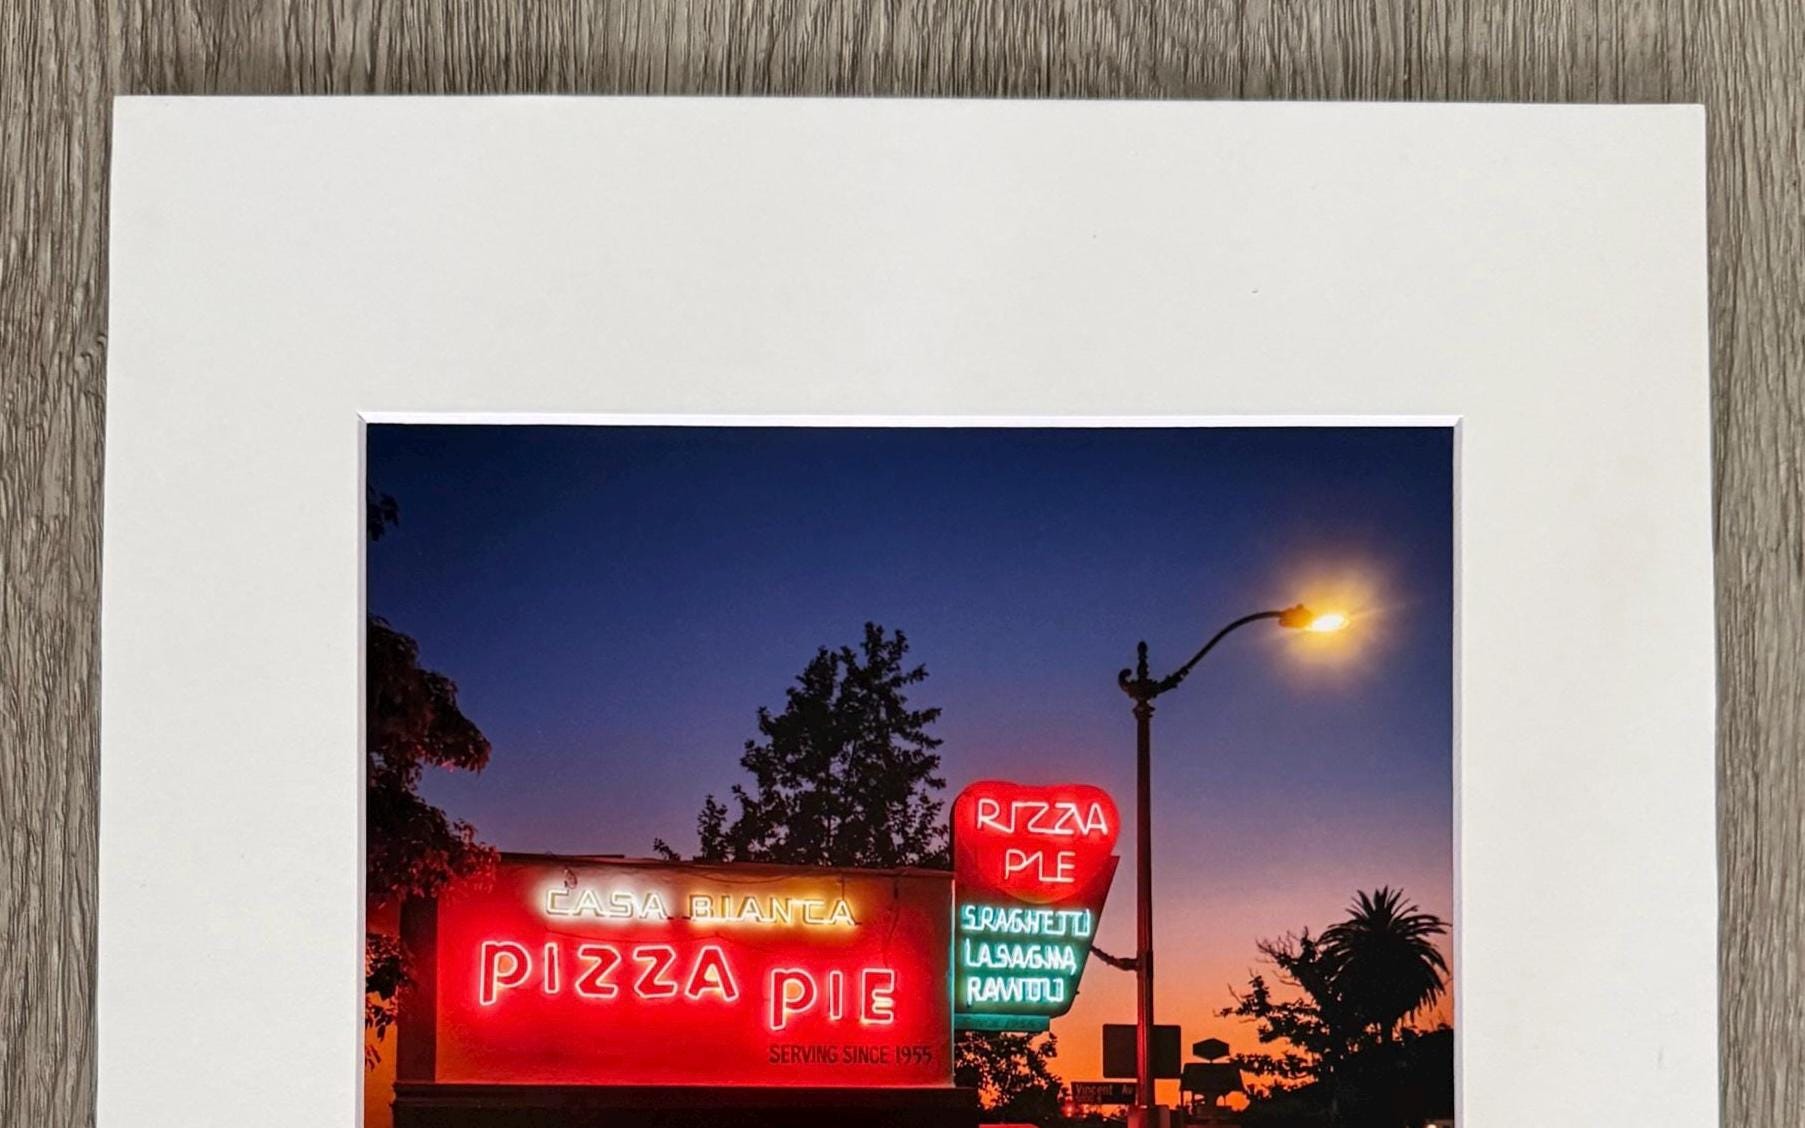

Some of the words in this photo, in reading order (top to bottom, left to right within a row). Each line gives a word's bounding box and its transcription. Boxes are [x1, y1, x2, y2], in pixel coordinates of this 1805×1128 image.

[545, 889, 669, 920] CASA
[688, 895, 858, 926] BIANCA
[479, 940, 741, 1006] PIZZA
[768, 967, 896, 1031] PIE
[768, 1044, 839, 1065] SERVING
[842, 1045, 889, 1065] SINCE
[894, 1046, 934, 1065] 1955
